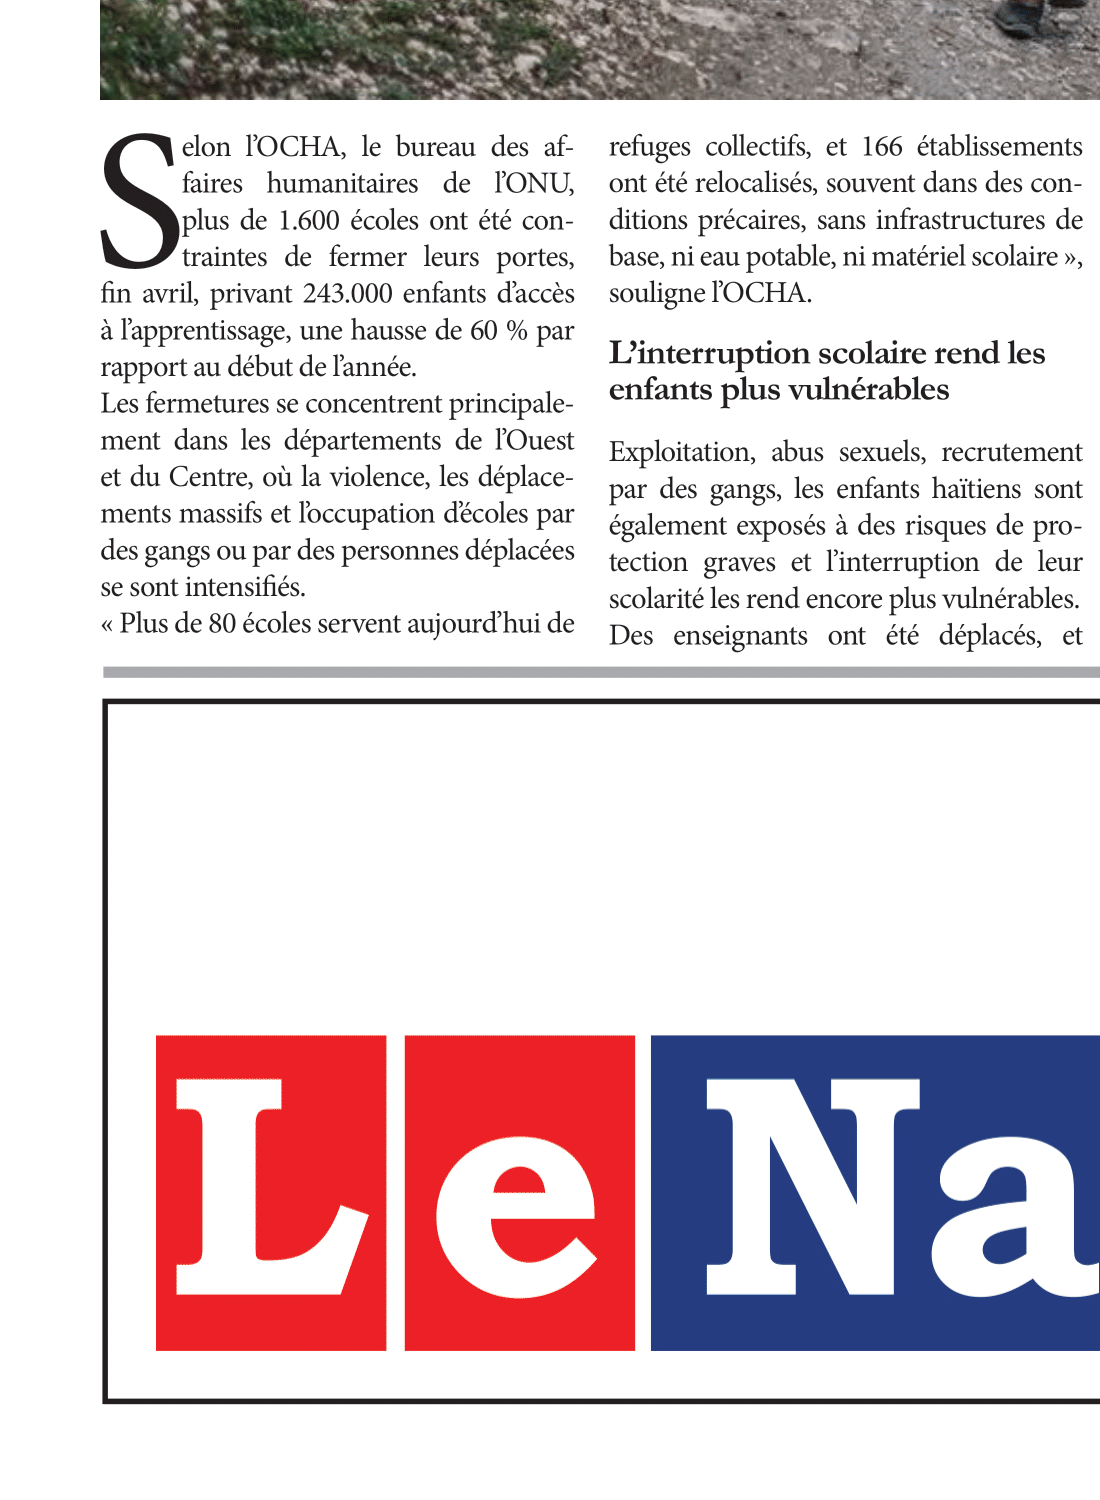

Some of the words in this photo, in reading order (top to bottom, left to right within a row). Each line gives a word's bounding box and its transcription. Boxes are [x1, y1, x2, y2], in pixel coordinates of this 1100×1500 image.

[610, 134, 690, 163] refuges
[706, 134, 811, 159] collectifs,
[827, 138, 847, 156] et
[864, 136, 902, 156] 166
[918, 134, 1082, 156] établissements
[101, 281, 131, 303] fin
[143, 281, 198, 306] avril,
[210, 283, 292, 310] privant
[304, 283, 392, 303] 243.000
[404, 281, 486, 303] enfants
[498, 281, 574, 303] d’accès
[101, 359, 188, 383] rapport
[194, 362, 221, 376] au
[228, 354, 293, 376] début
[300, 354, 326, 376] de
[333, 354, 416, 376] l’année.
[609, 340, 810, 372] L’interruption
[819, 340, 926, 364] scolaire
[935, 340, 1000, 364] rend
[1008, 340, 1045, 364] les
[610, 376, 712, 400] enfants
[721, 376, 780, 409] plus
[788, 376, 949, 400] vulnérables
[101, 432, 160, 450] ment
[175, 428, 227, 450] dans
[241, 428, 270, 450] les
[285, 428, 441, 457] départements
[456, 428, 482, 450] de
[496, 428, 574, 450] l’Ouest
[609, 439, 755, 468] Exploitation,
[772, 439, 823, 461] abus
[840, 439, 926, 464] sexuels,
[942, 444, 1083, 461] recrutement
[101, 469, 121, 486] et
[131, 464, 160, 486] du
[170, 466, 253, 489] Centre,
[263, 466, 292, 486] où
[301, 464, 321, 486] la
[330, 464, 430, 489] violence,
[439, 464, 468, 486] les
[479, 464, 573, 493] déplace-
[610, 625, 653, 645] Des
[674, 625, 807, 652] enseignants
[829, 627, 866, 645] ont
[887, 624, 919, 645] été
[940, 623, 1041, 652] déplacés,
[1063, 627, 1083, 645] et
